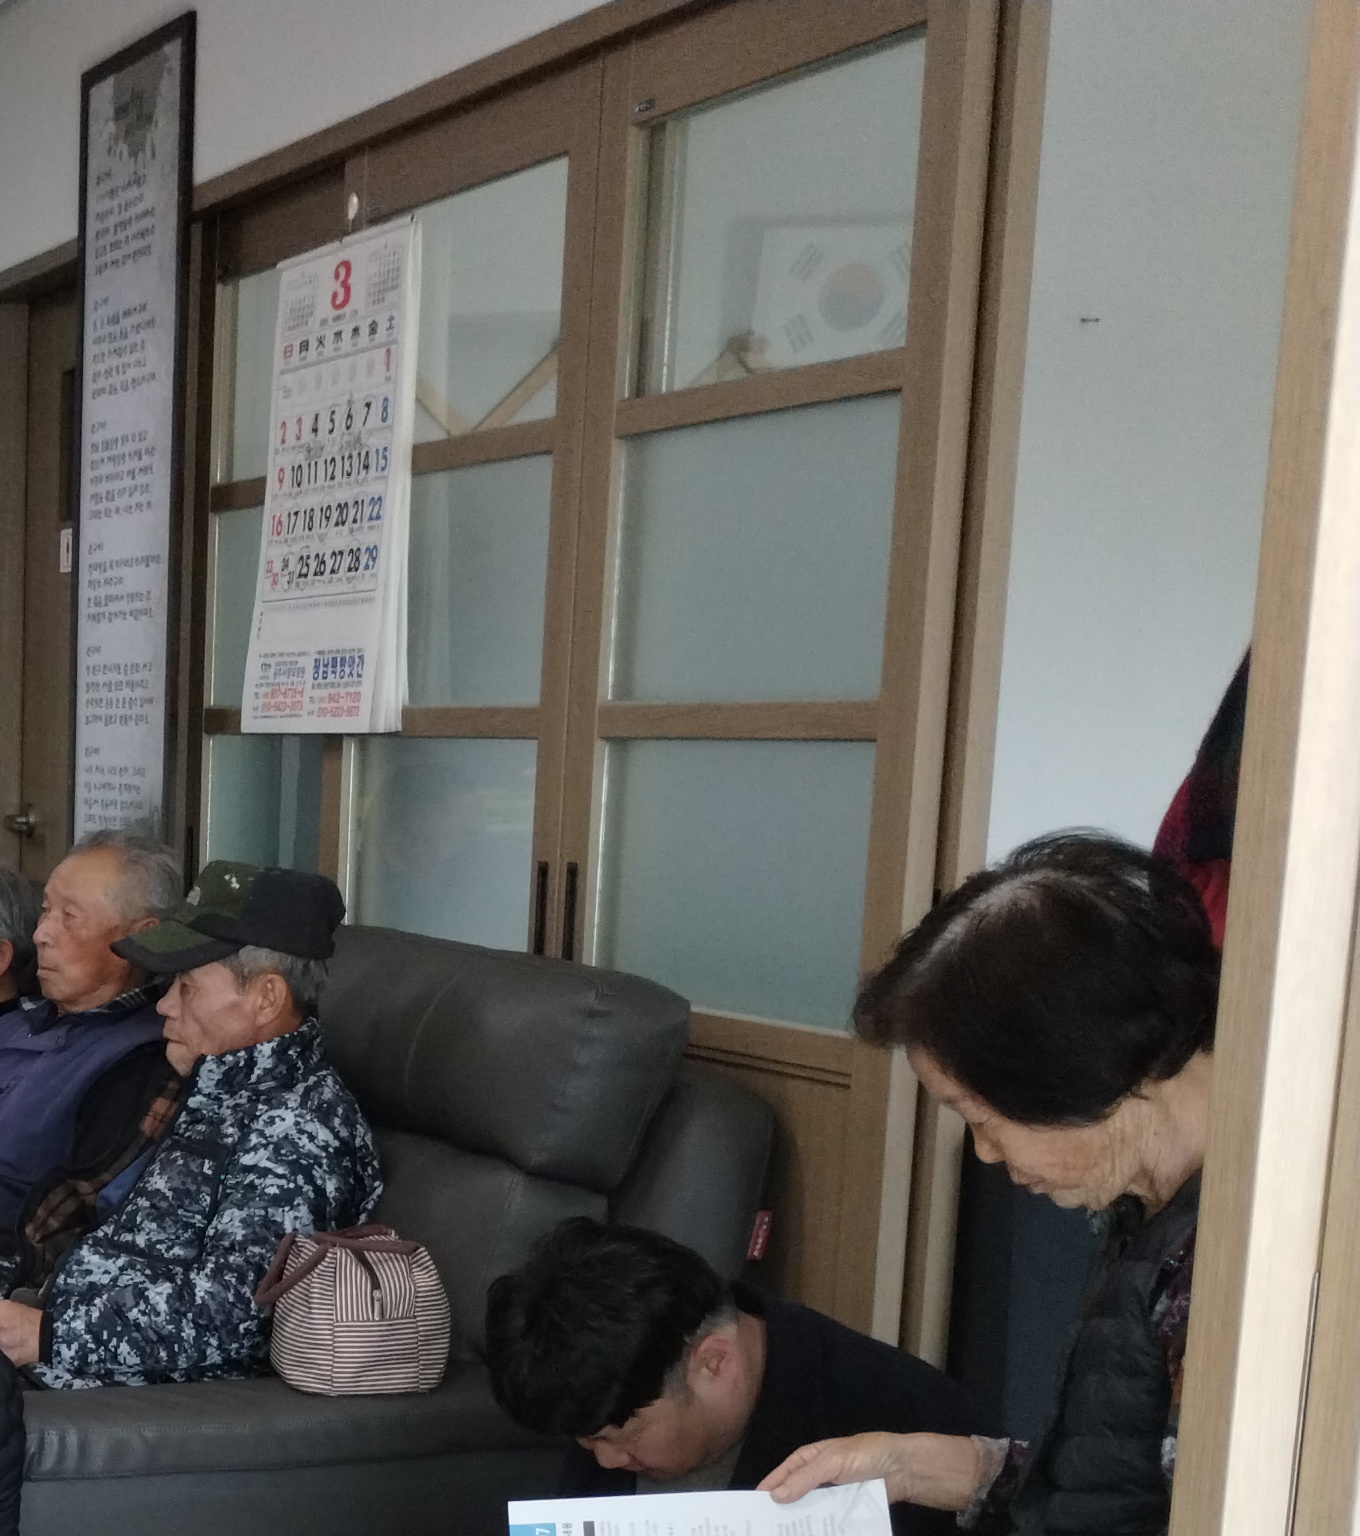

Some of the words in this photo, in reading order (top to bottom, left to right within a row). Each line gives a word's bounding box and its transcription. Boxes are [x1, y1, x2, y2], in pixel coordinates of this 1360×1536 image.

[331, 259, 352, 311] 3
[283, 343, 294, 360] 日
[299, 339, 310, 355] 月
[316, 334, 326, 349] 火
[332, 330, 343, 345] 水
[351, 325, 360, 339] 木
[368, 319, 379, 337] 金
[386, 314, 395, 331] 土
[280, 420, 287, 445] 2
[295, 417, 303, 441] 3
[311, 413, 319, 438] 4
[328, 410, 336, 435] 5
[345, 407, 353, 431] 6
[363, 401, 372, 427] 7
[381, 396, 389, 423] 8
[277, 467, 285, 490] 9
[291, 464, 303, 489] 10
[307, 460, 318, 485] 11
[324, 456, 336, 482] 12
[341, 452, 353, 478] 13
[357, 450, 370, 476] 14
[375, 446, 388, 472] 15
[271, 513, 283, 537] 16
[286, 510, 299, 535] 17
[303, 508, 314, 532] 18
[319, 504, 331, 530] 19
[334, 501, 349, 527] 20
[351, 499, 365, 524] 21
[367, 495, 382, 522] 22
[297, 554, 310, 579] 25
[313, 553, 326, 577] 26
[329, 550, 344, 575] 27
[346, 547, 361, 573] 28
[363, 544, 378, 571] 29
